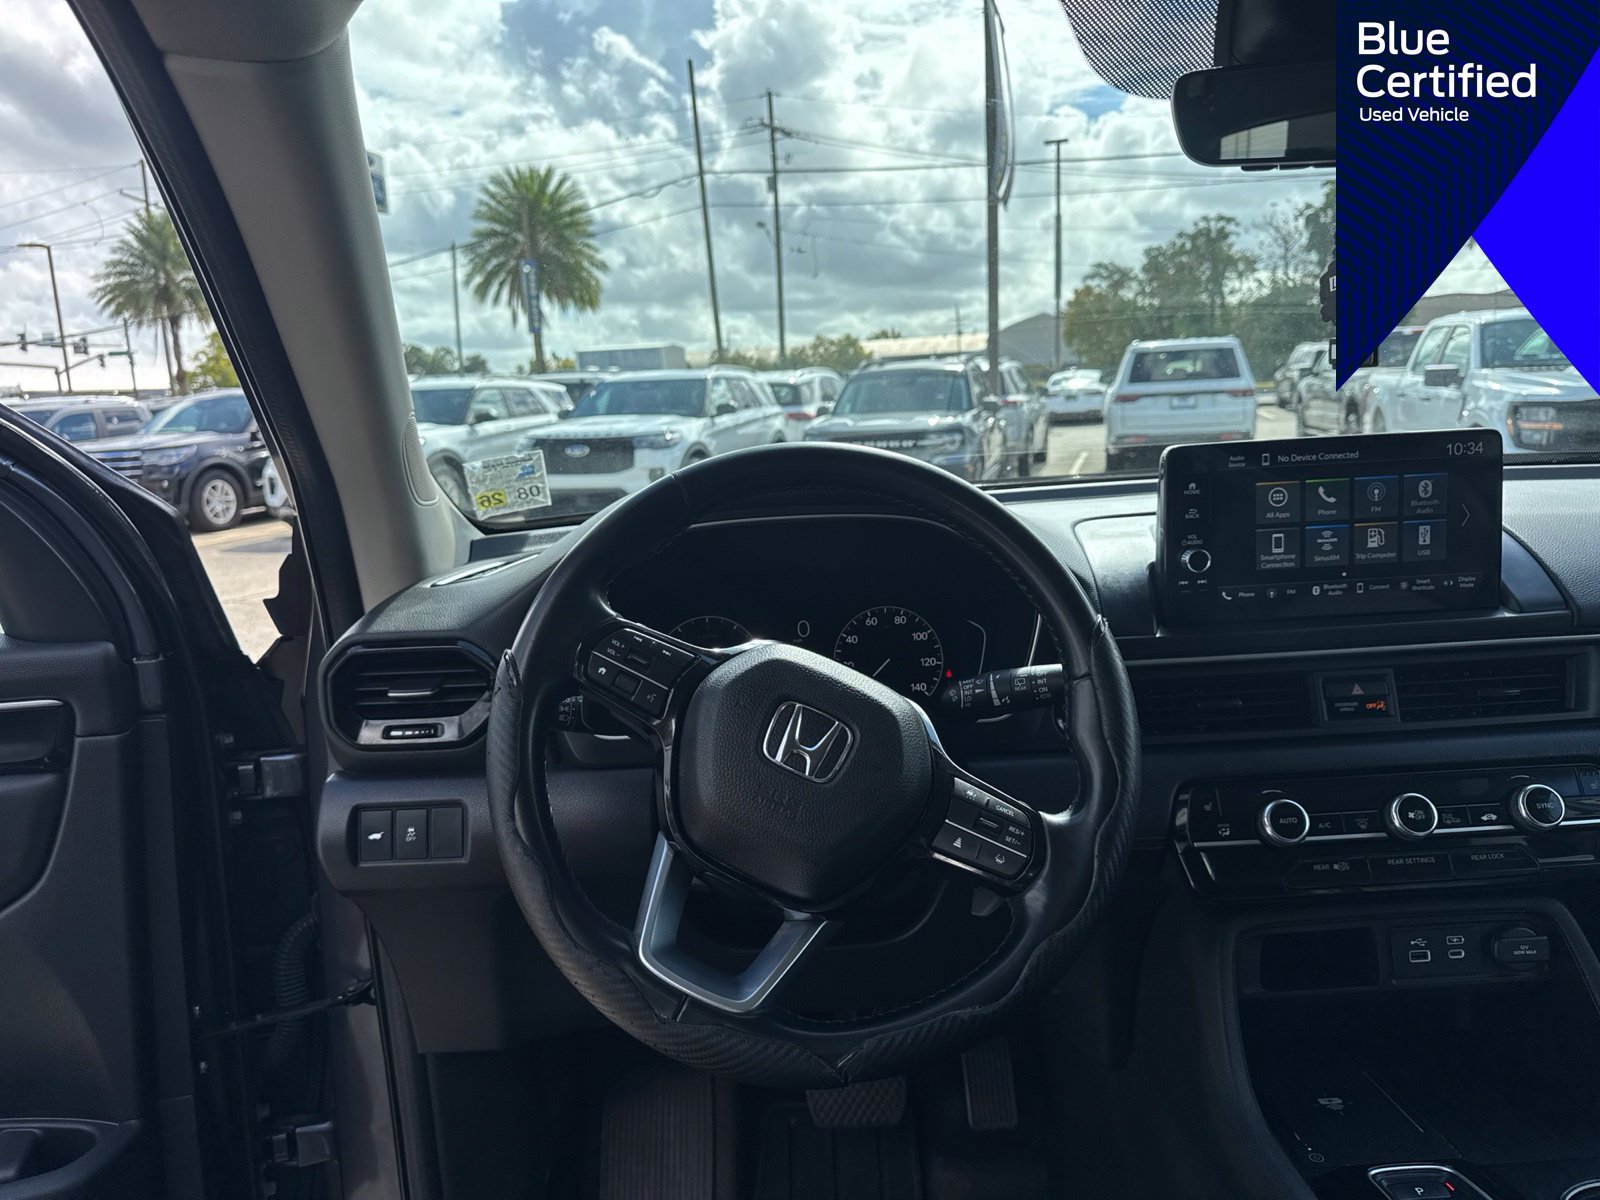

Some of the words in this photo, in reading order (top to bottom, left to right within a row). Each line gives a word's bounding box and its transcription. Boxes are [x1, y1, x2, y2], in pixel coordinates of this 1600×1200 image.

[1446, 441, 1485, 456] 10:34
[1277, 454, 1289, 463] No
[1291, 452, 1317, 462] Device
[1318, 450, 1359, 461] Connected
[1275, 511, 1291, 519] Apps
[1260, 554, 1296, 562] Smartphone
[1314, 554, 1340, 562] SiriusXM
[1367, 551, 1397, 560] Computer
[865, 616, 878, 626] 60
[894, 615, 907, 625] 80
[845, 634, 858, 644] 40
[911, 632, 929, 641] 100
[920, 657, 937, 667] 120
[910, 682, 927, 692] 140
[1535, 802, 1555, 810] SYNC
[996, 805, 1015, 817] CANCEL
[1279, 816, 1298, 825] AUTO
[1318, 821, 1333, 830] A/C
[1405, 856, 1436, 864] SETTINGS
[1313, 863, 1330, 871] REAR
[1414, 1187, 1424, 1196] P
